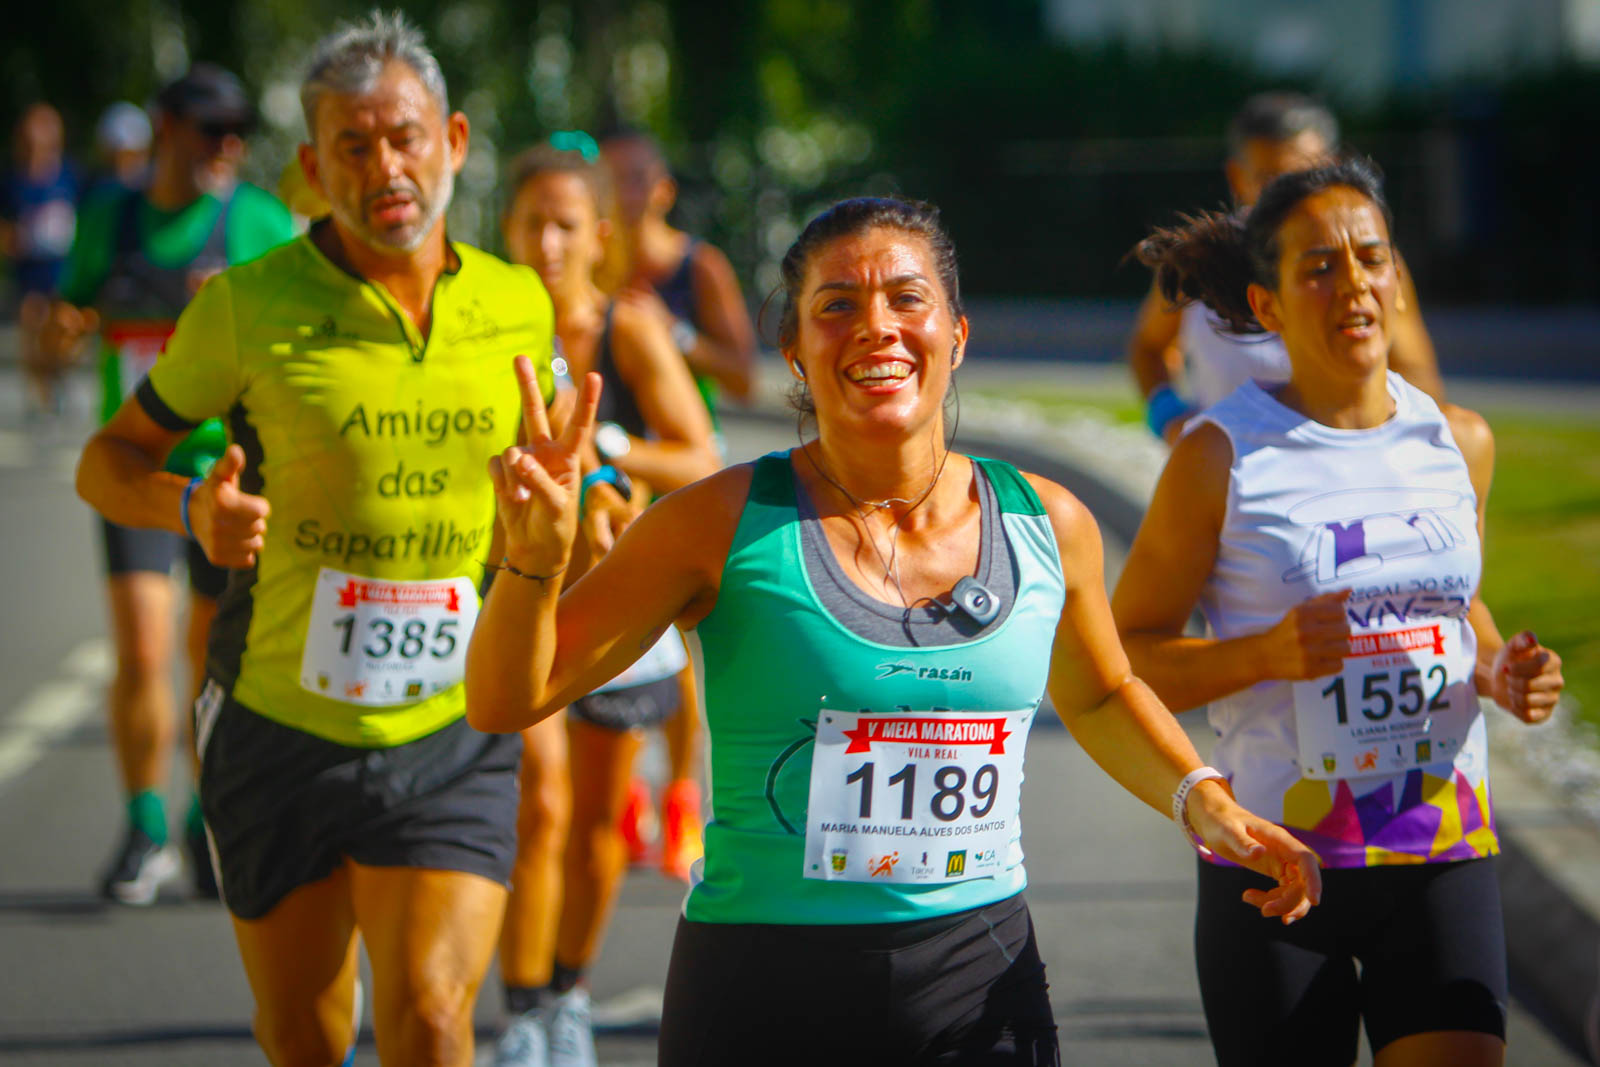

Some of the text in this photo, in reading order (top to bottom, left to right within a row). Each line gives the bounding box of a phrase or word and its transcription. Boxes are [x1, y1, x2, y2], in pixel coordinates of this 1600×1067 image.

[339, 399, 495, 448] Amigos
[377, 460, 449, 499] das
[332, 613, 459, 660] 1385
[1321, 664, 1451, 725] 1552
[867, 722, 995, 741] V MEIA MARATONA
[908, 747, 958, 760] VILA REAL
[846, 761, 999, 822] 1189
[821, 820, 1005, 837] MARIA MANUELA ALVES DOS SANTOS
[984, 849, 996, 862] CA
